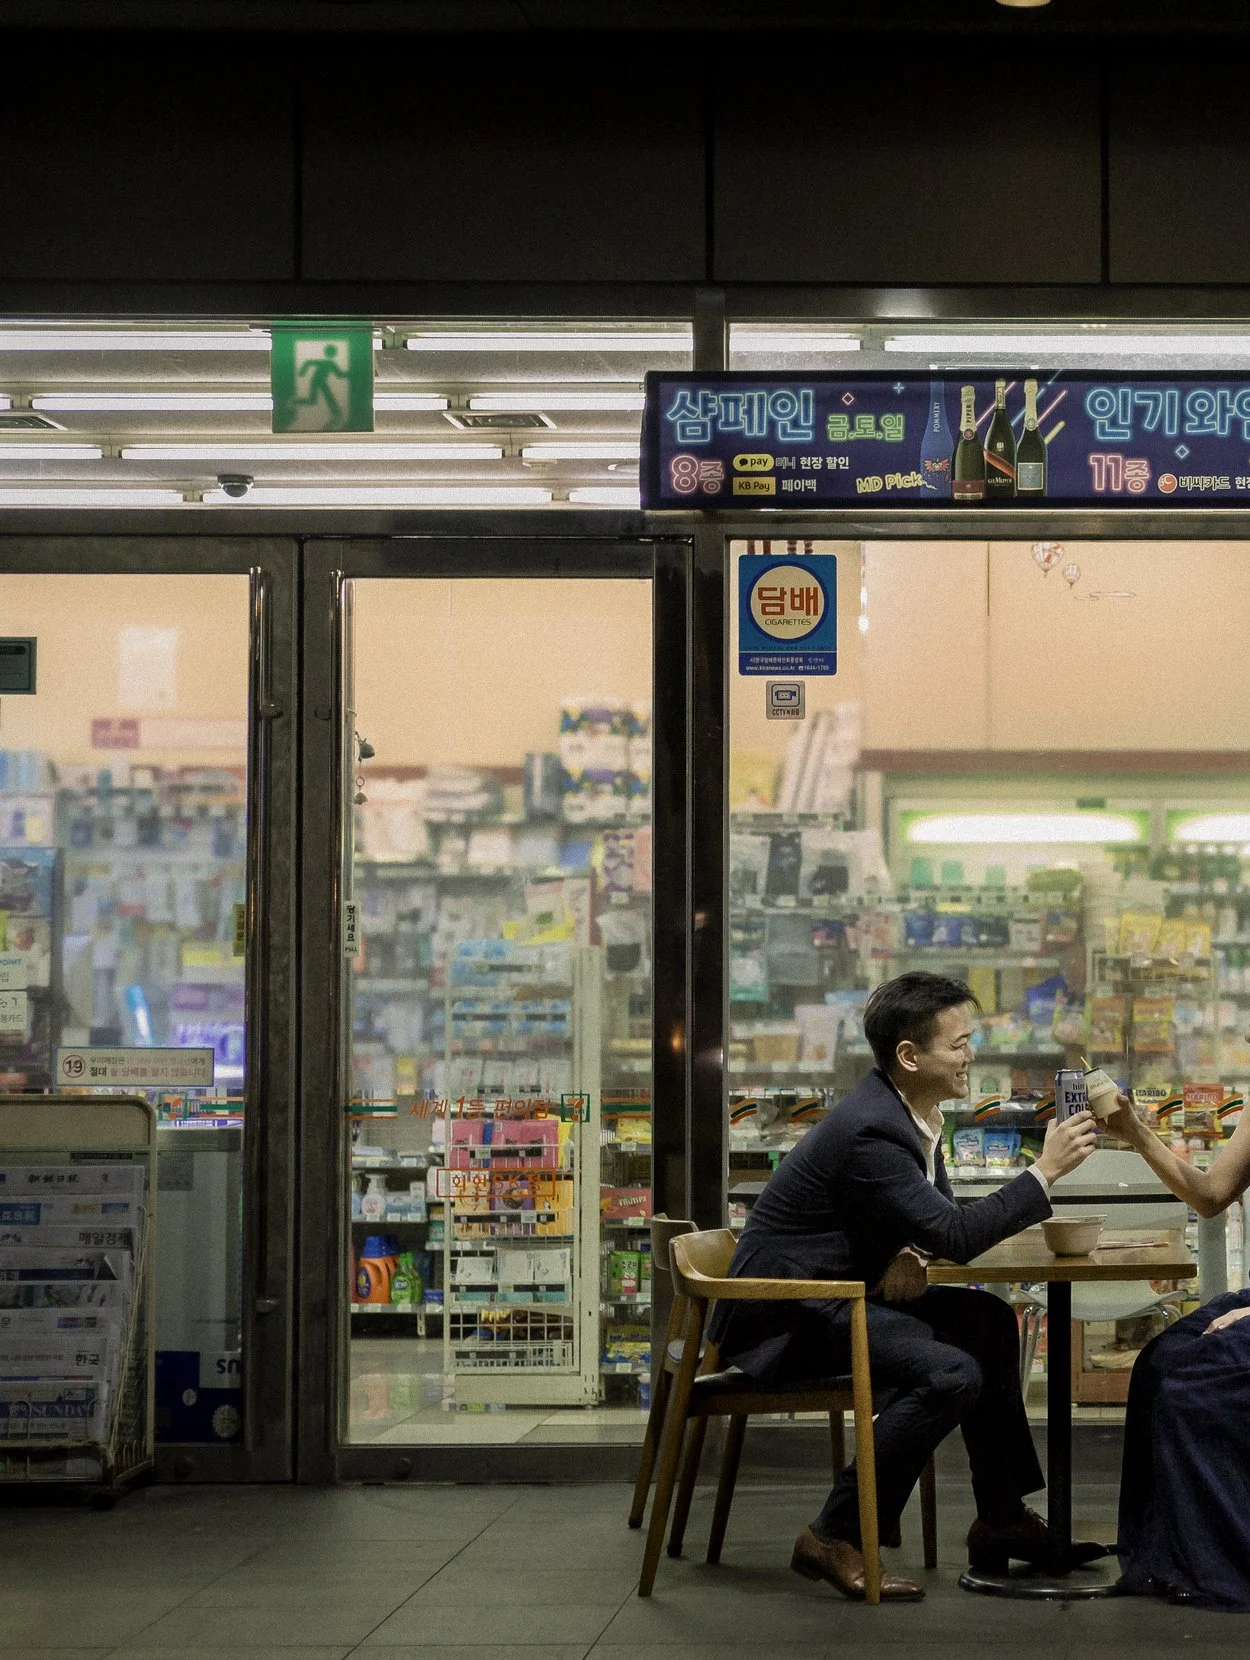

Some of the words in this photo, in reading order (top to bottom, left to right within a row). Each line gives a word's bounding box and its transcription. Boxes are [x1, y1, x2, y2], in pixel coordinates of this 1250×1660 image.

[666, 390, 814, 443] 샴페인
[671, 455, 725, 495] 8종
[750, 459, 769, 470] pay
[800, 457, 823, 470] 현장
[826, 457, 850, 470] 할인
[1089, 455, 1150, 493] 11종
[738, 482, 752, 491] KB
[753, 482, 771, 492] Pay
[781, 479, 817, 493] 페이백
[856, 475, 883, 494] MD
[884, 471, 924, 491] Pick
[757, 586, 820, 617] 담배
[764, 618, 812, 626] CIGARETTES
[346, 905, 356, 942] 당기세요
[65, 1060, 83, 1074] 19
[90, 1066, 107, 1077] 절대
[1135, 1088, 1167, 1097] HARIBO
[409, 1099, 448, 1120] 세계
[454, 1095, 485, 1120] 1등
[493, 1099, 551, 1120] 편의점
